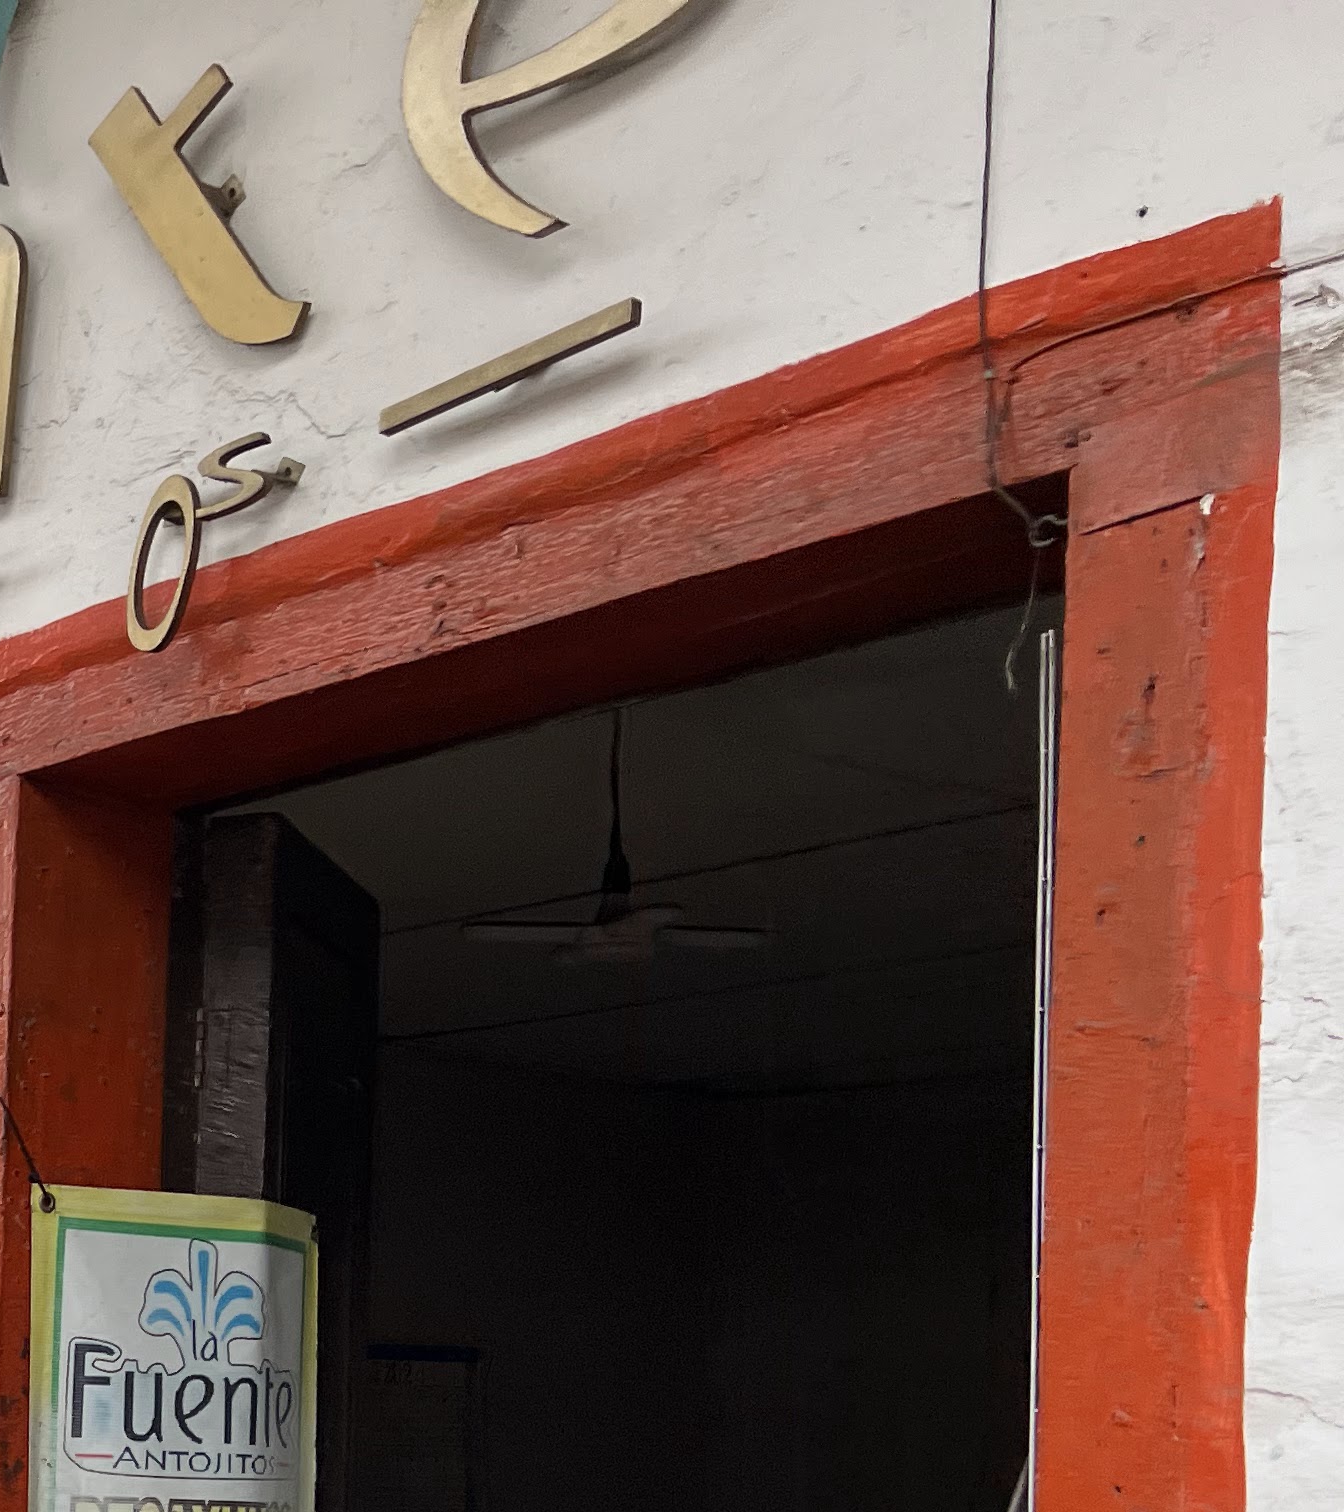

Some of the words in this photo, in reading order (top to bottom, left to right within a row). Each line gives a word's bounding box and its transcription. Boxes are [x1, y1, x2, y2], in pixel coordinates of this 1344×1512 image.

[193, 1319, 218, 1361] la
[71, 1342, 292, 1448] Fuente
[113, 1447, 276, 1475] ANTOJITOS
